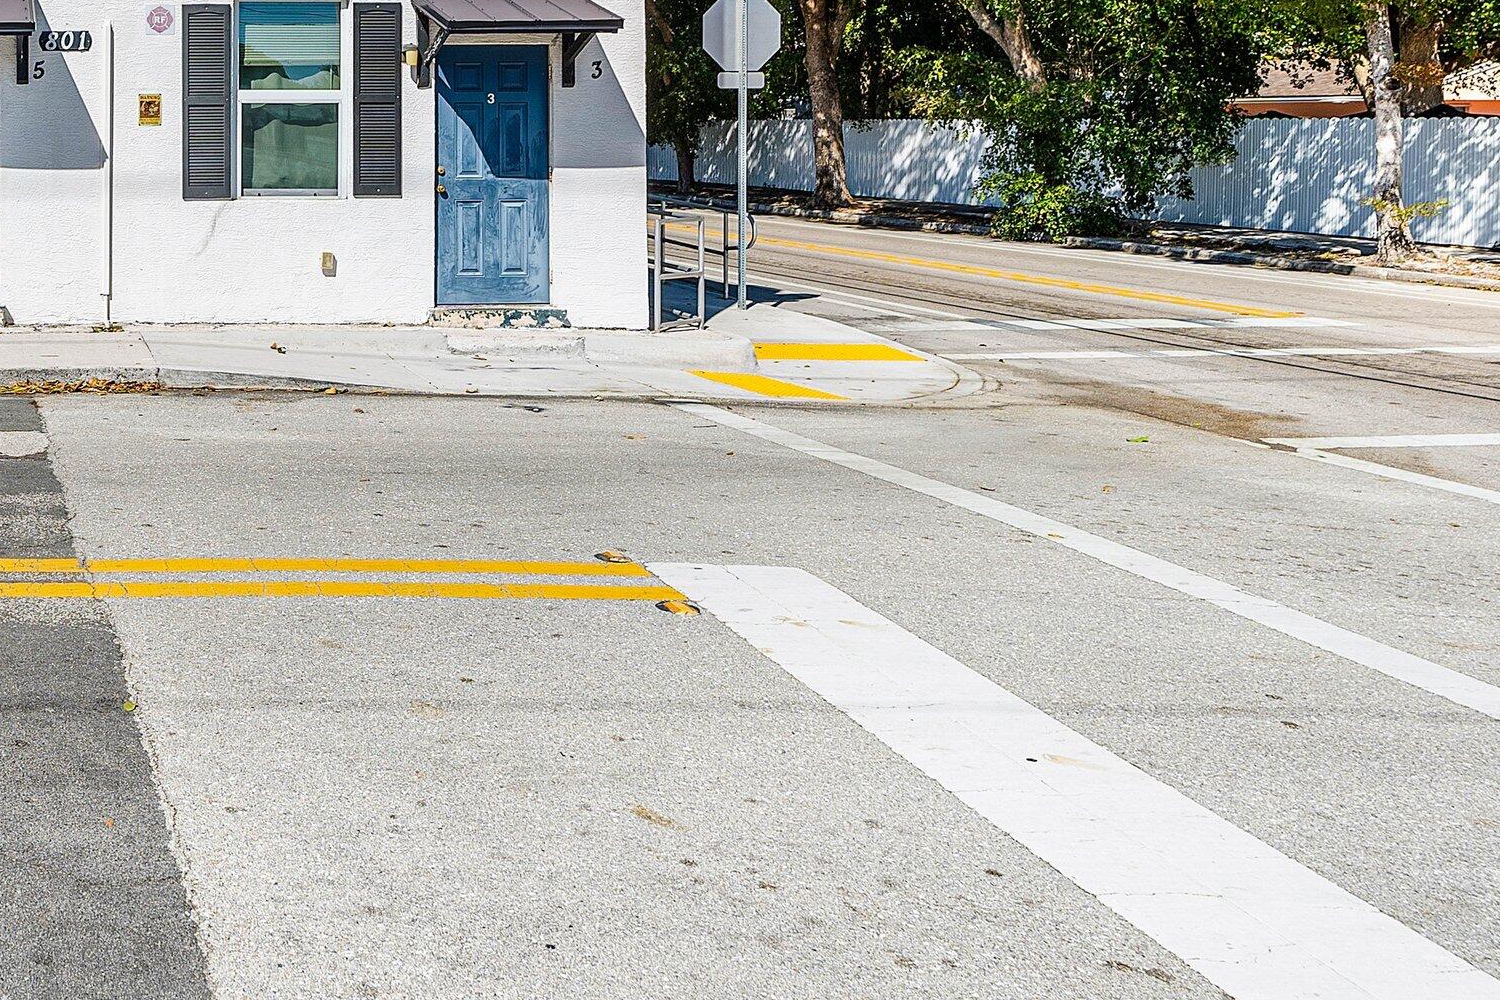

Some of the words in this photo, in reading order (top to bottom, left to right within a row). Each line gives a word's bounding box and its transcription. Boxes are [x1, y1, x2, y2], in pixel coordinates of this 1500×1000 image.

[154, 16, 166, 24] RF
[45, 31, 87, 51] 801
[32, 61, 45, 79] 5
[591, 60, 603, 79] 3
[487, 93, 495, 104] 3
